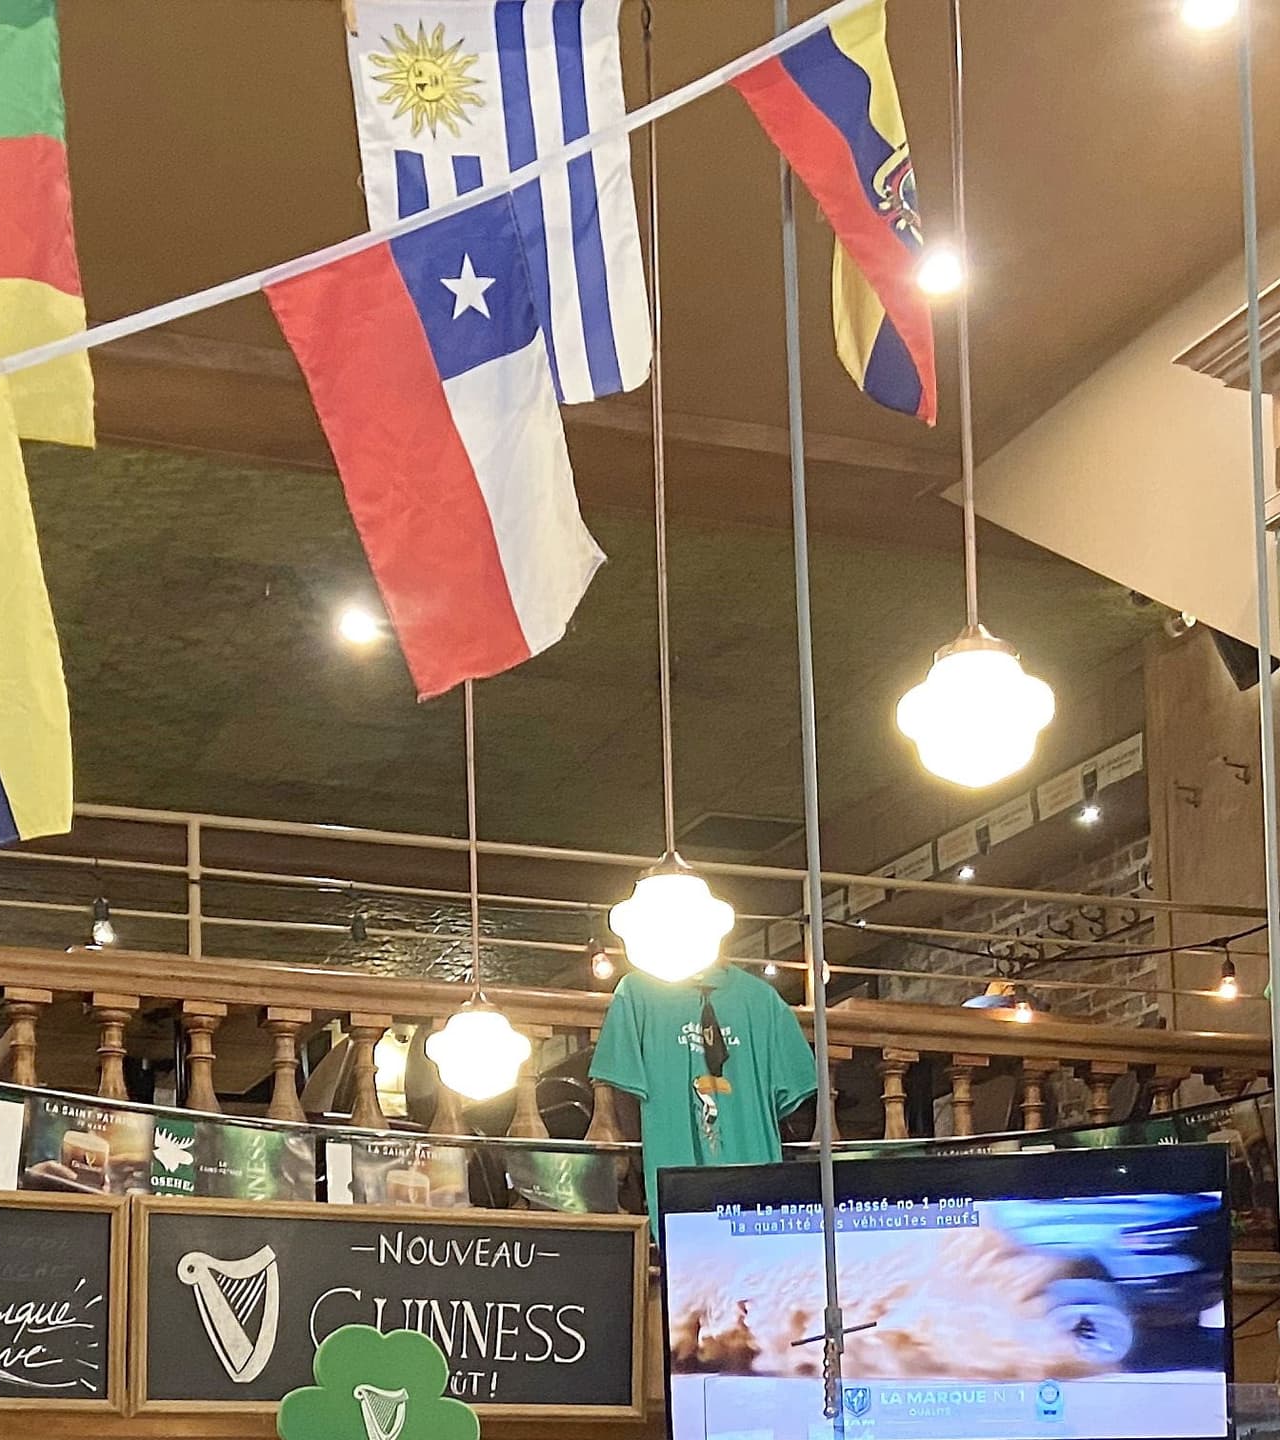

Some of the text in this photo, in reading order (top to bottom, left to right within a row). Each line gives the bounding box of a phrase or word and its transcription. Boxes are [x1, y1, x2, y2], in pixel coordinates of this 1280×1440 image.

[45, 1102, 59, 1114] LA
[756, 1201, 773, 1217] La
[781, 1202, 823, 1218] marqu
[838, 1197, 889, 1214] classé
[896, 1199, 915, 1211] no
[921, 1196, 930, 1210] 1
[731, 1219, 747, 1234] la
[753, 1217, 812, 1235] qualité
[852, 1213, 928, 1229] véhicules
[935, 1211, 979, 1226] neufs
[378, 1229, 537, 1269] NOUVEAU
[906, 1390, 987, 1405] MARQUE
